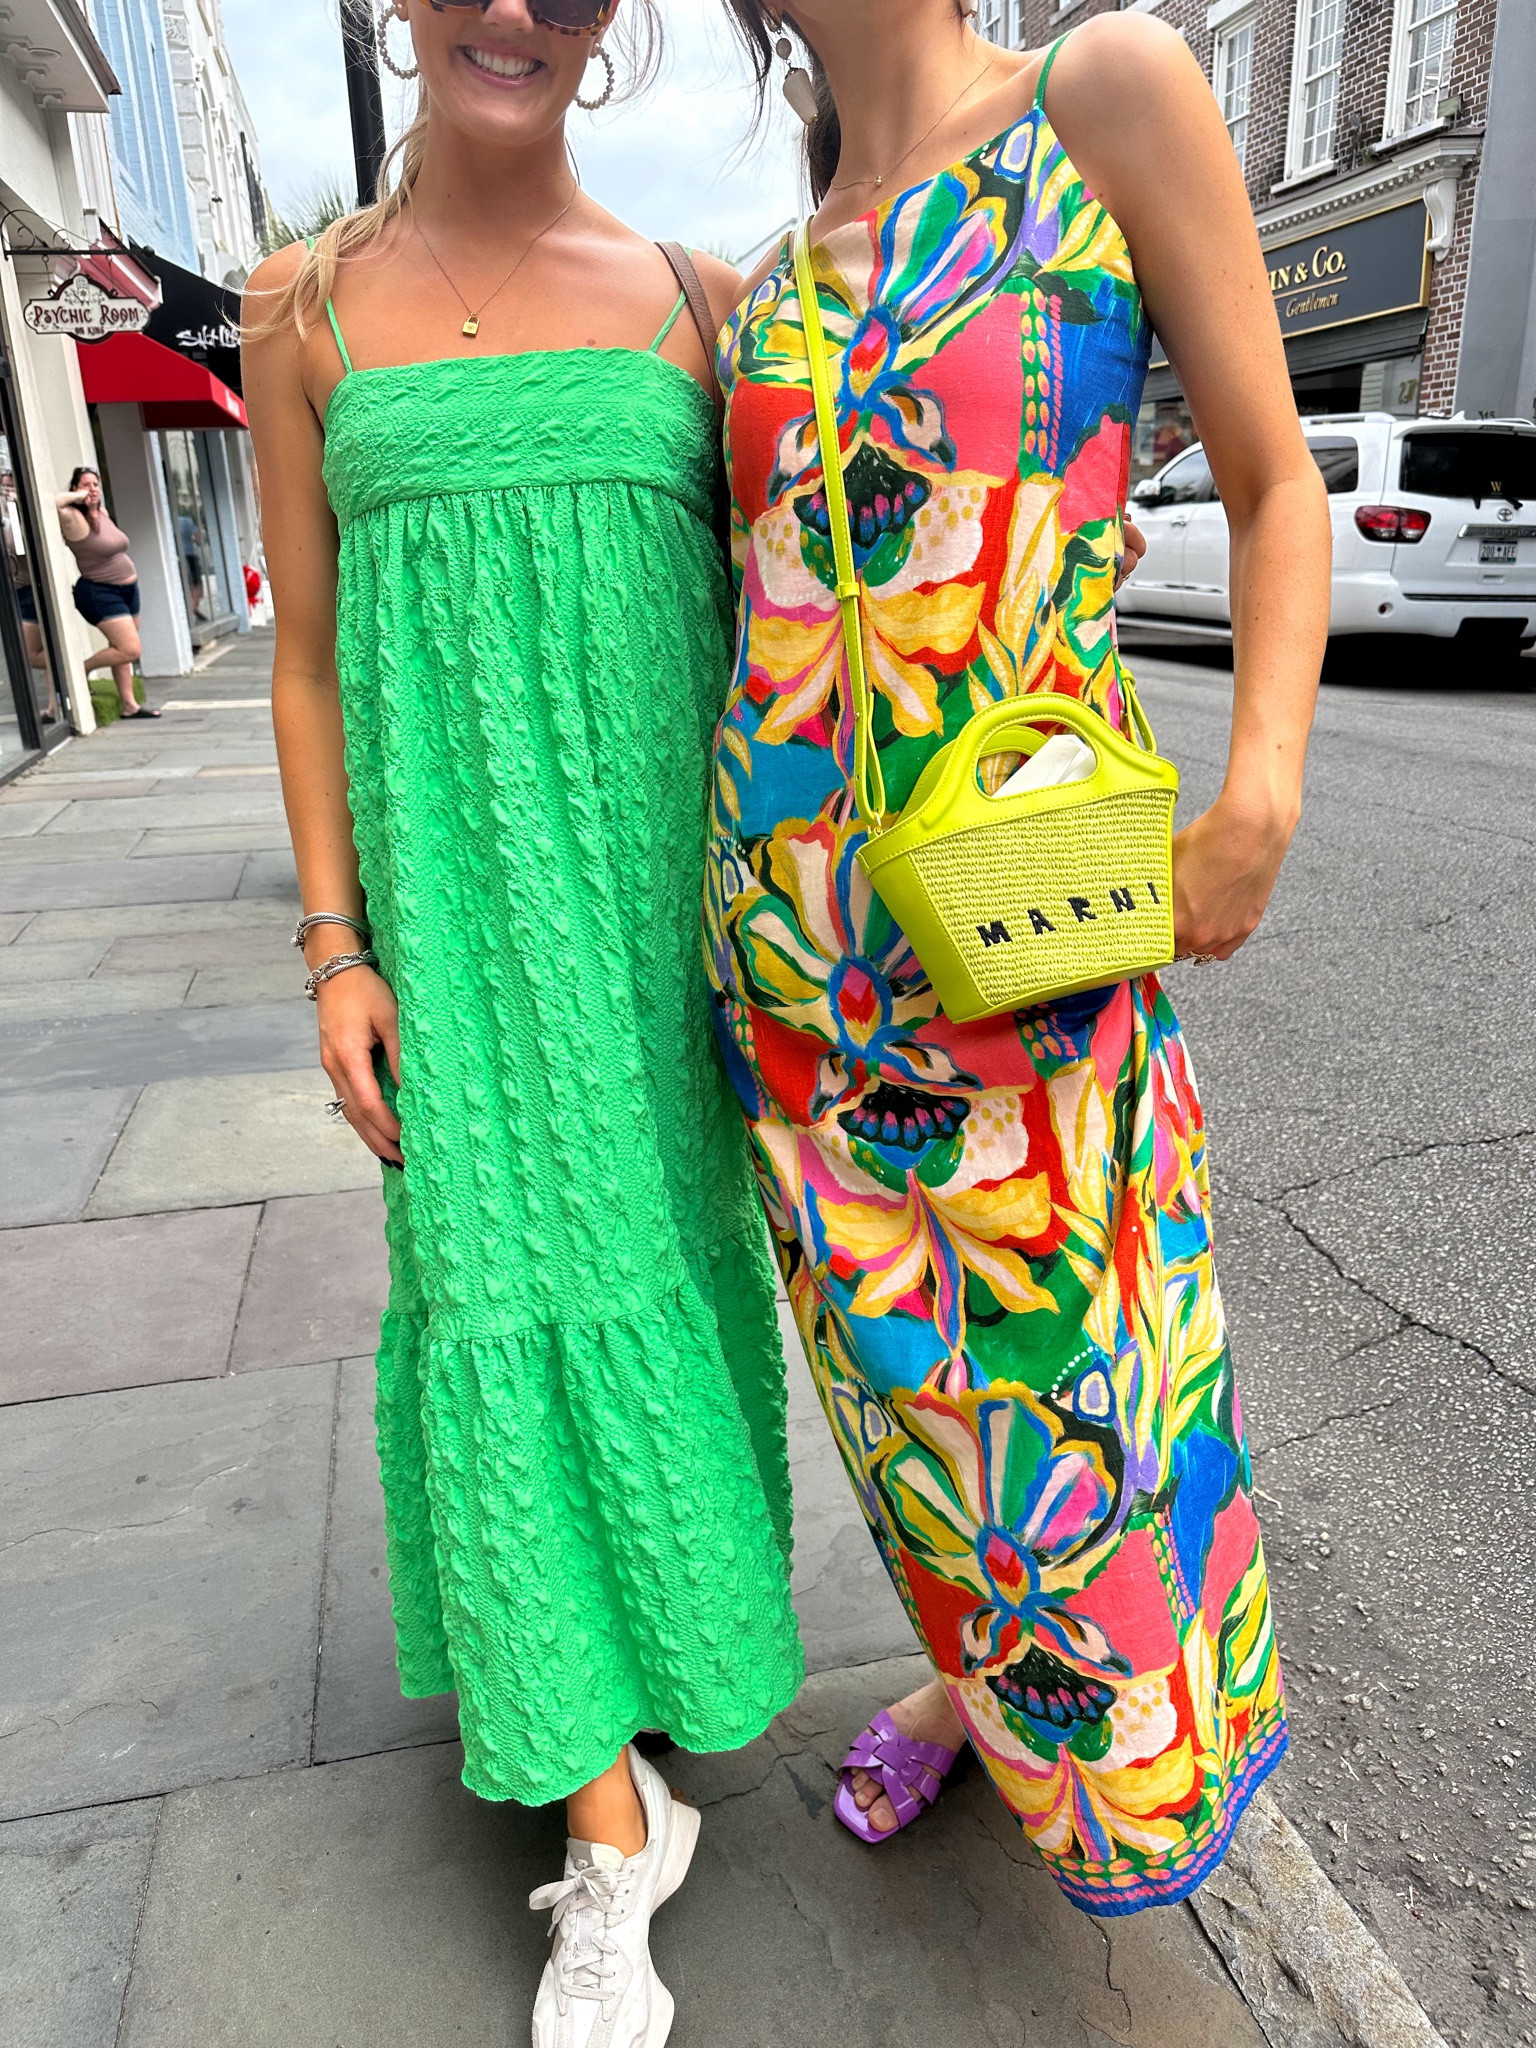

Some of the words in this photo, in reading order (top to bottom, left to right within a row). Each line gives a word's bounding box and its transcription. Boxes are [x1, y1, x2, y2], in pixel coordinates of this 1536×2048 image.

[1269, 265, 1291, 291] IN
[1294, 262, 1308, 284] &
[1286, 292, 1339, 318] Gentlemen
[88, 326, 105, 336] KING
[976, 881, 1160, 948] MARNI
